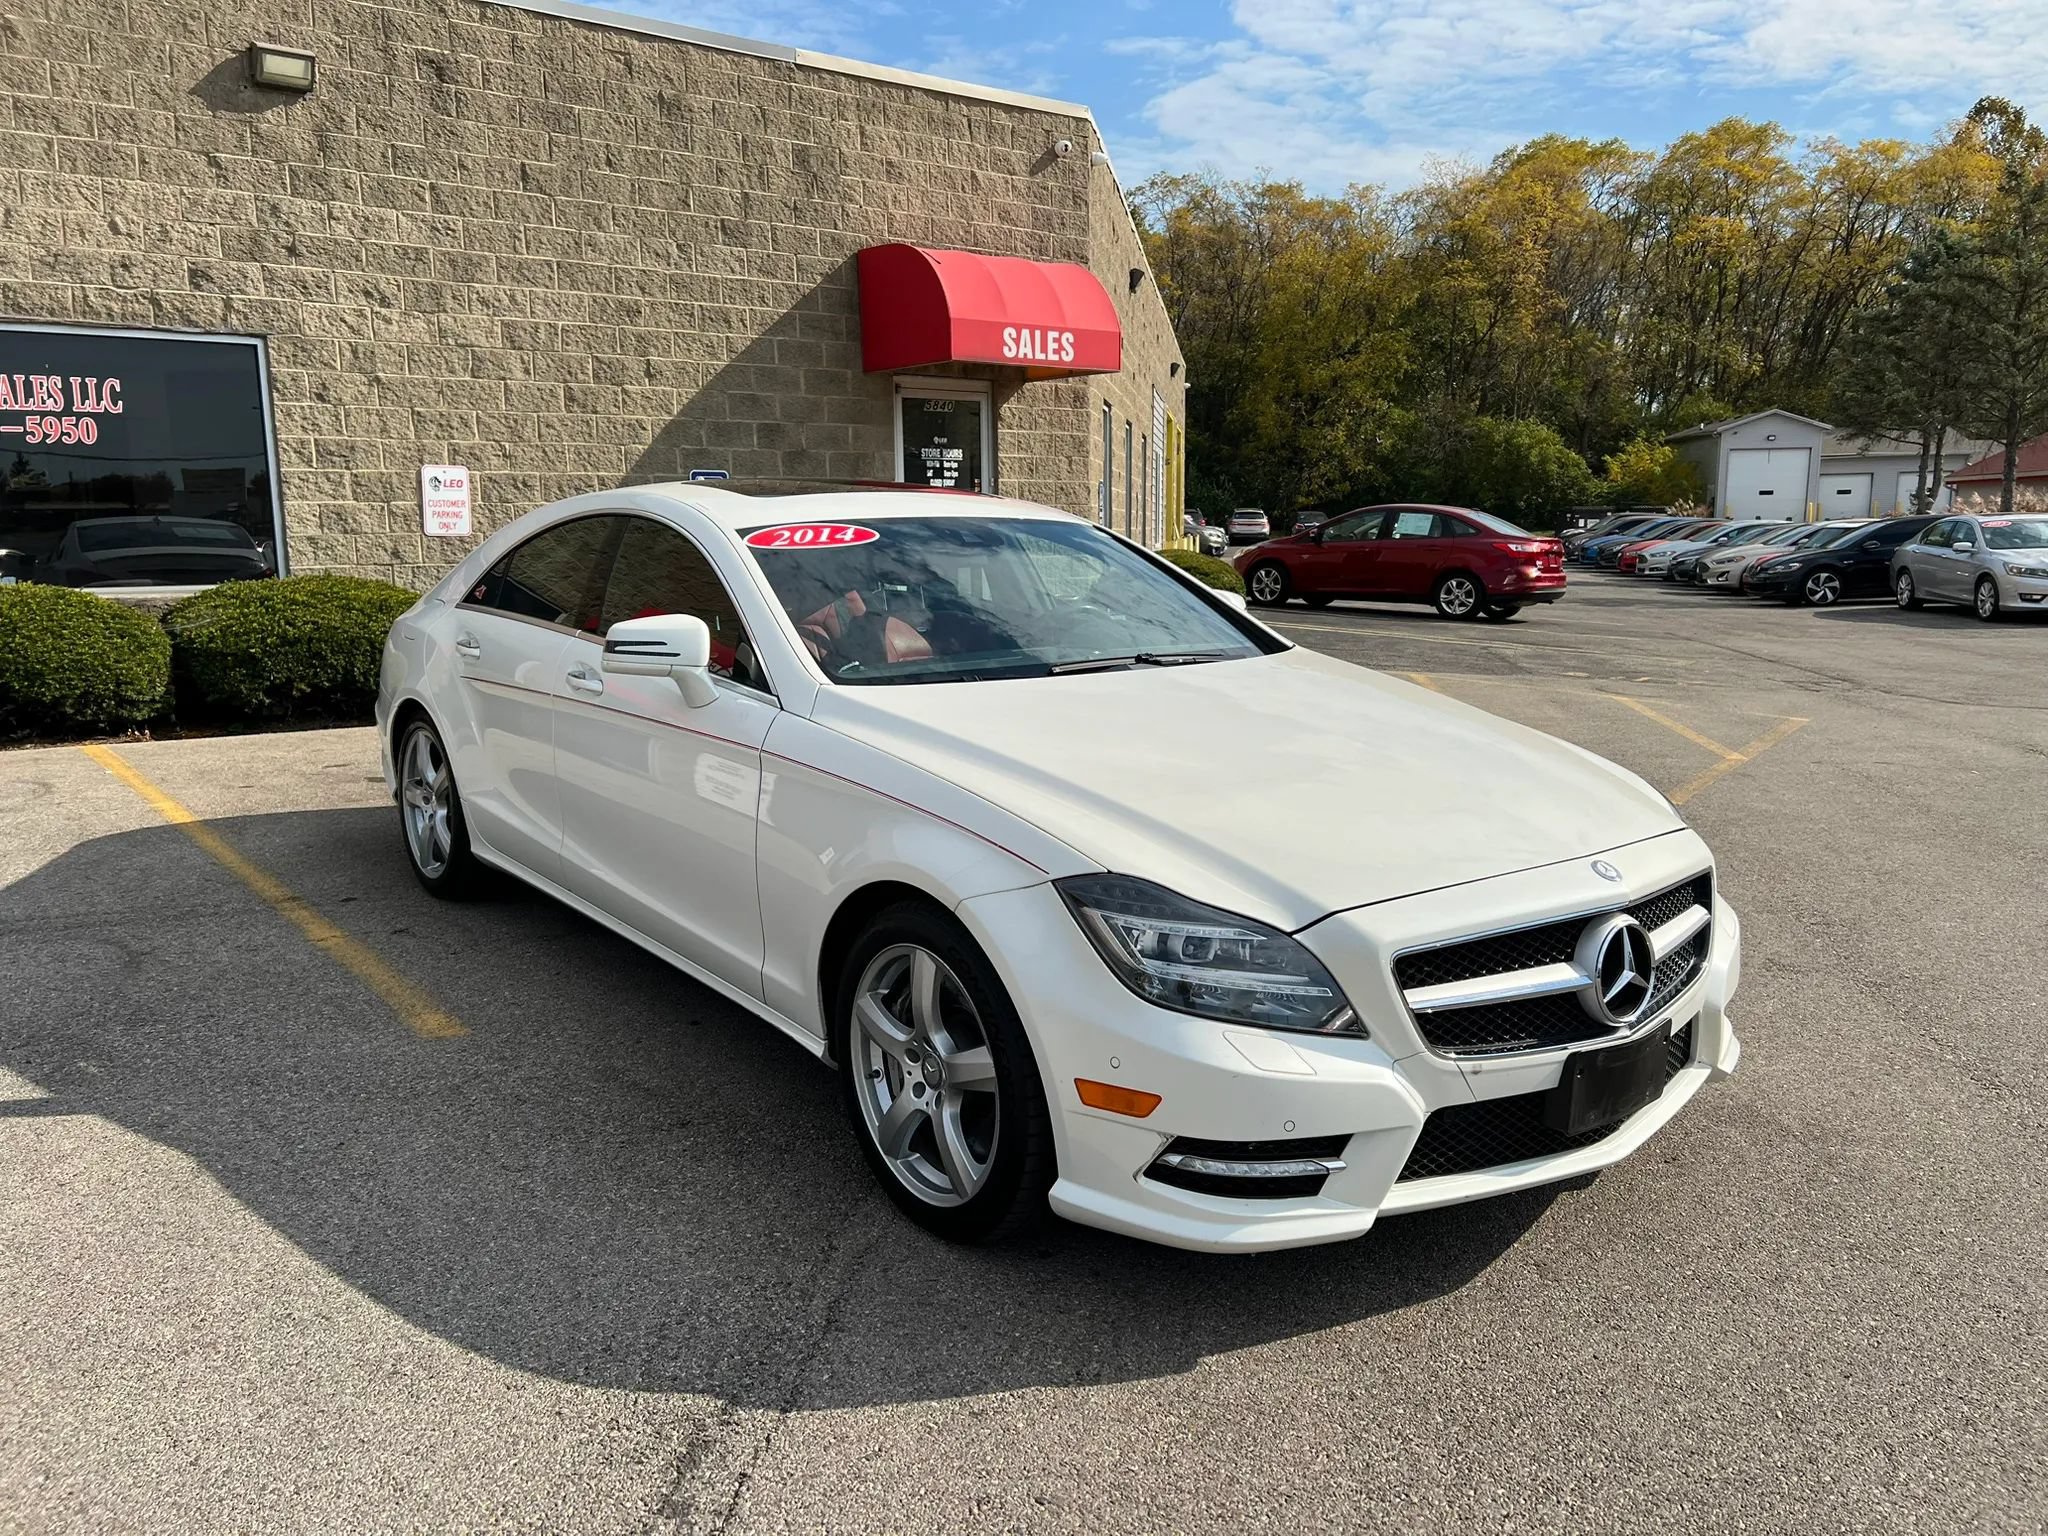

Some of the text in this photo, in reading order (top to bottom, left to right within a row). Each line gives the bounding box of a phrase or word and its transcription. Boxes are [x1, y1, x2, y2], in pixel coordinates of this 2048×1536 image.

[1002, 326, 1075, 362] SALES
[69, 377, 123, 413] LLC
[925, 400, 954, 411] 5840
[921, 448, 963, 458] STORE HOURS
[443, 479, 464, 488] LEO
[428, 499, 466, 508] CUSTOMER
[432, 510, 463, 519] PARKING
[438, 521, 457, 530] ONLY
[771, 527, 855, 546] 2014
